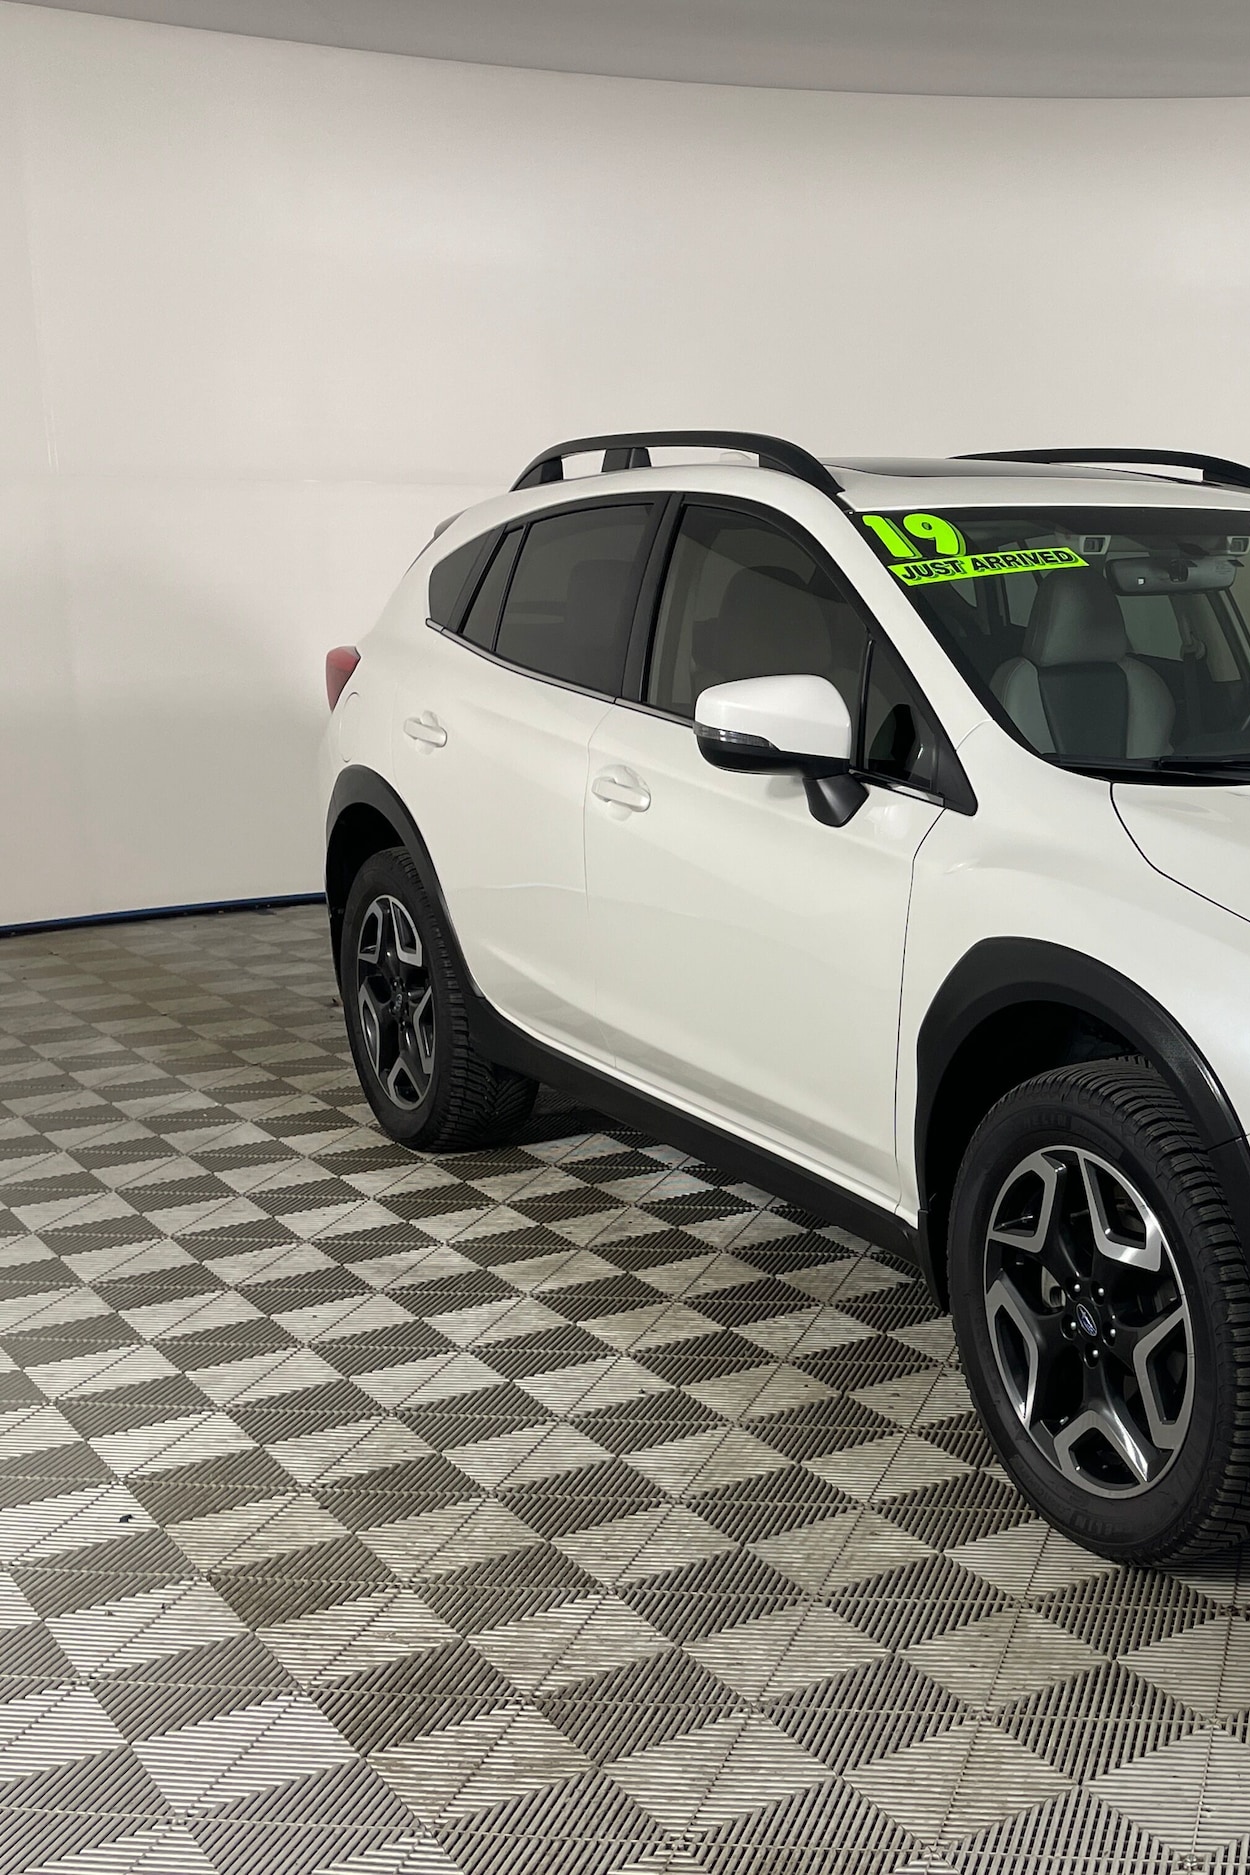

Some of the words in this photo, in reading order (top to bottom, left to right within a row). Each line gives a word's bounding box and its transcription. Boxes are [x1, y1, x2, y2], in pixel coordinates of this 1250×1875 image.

[862, 513, 966, 559] 19
[902, 560, 963, 580] JUST
[971, 550, 1076, 572] ARRIVED
